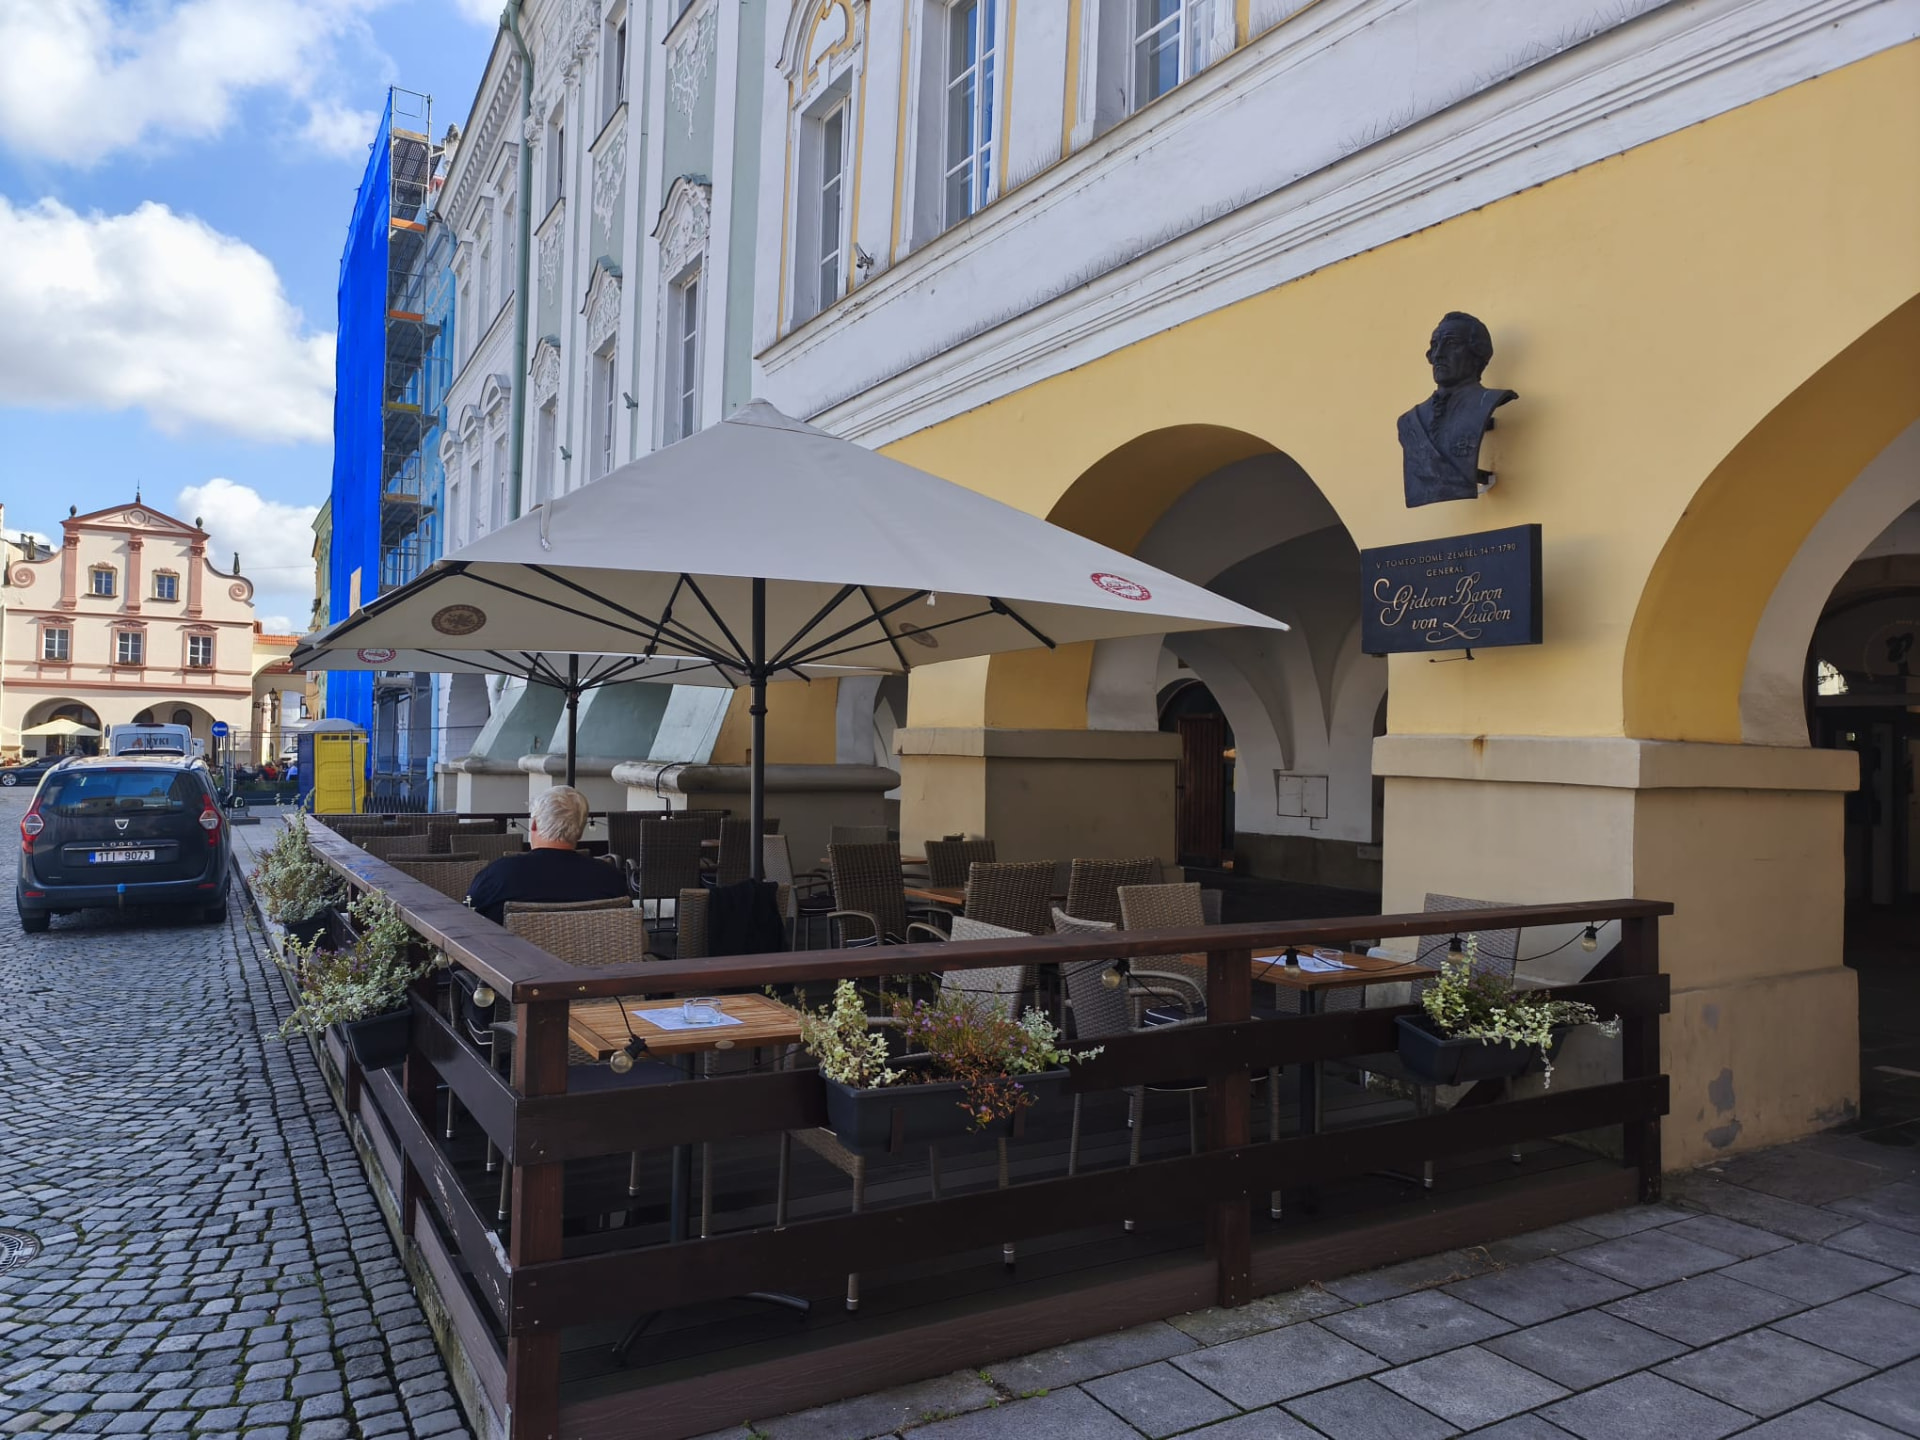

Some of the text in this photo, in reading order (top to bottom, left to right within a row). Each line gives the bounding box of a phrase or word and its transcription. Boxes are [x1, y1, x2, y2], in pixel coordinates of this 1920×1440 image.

[1385, 557, 1416, 568] TOMTO
[1373, 571, 1503, 626] Gideon Baron
[1412, 600, 1511, 643] von Laudon
[124, 850, 151, 861] 9073
